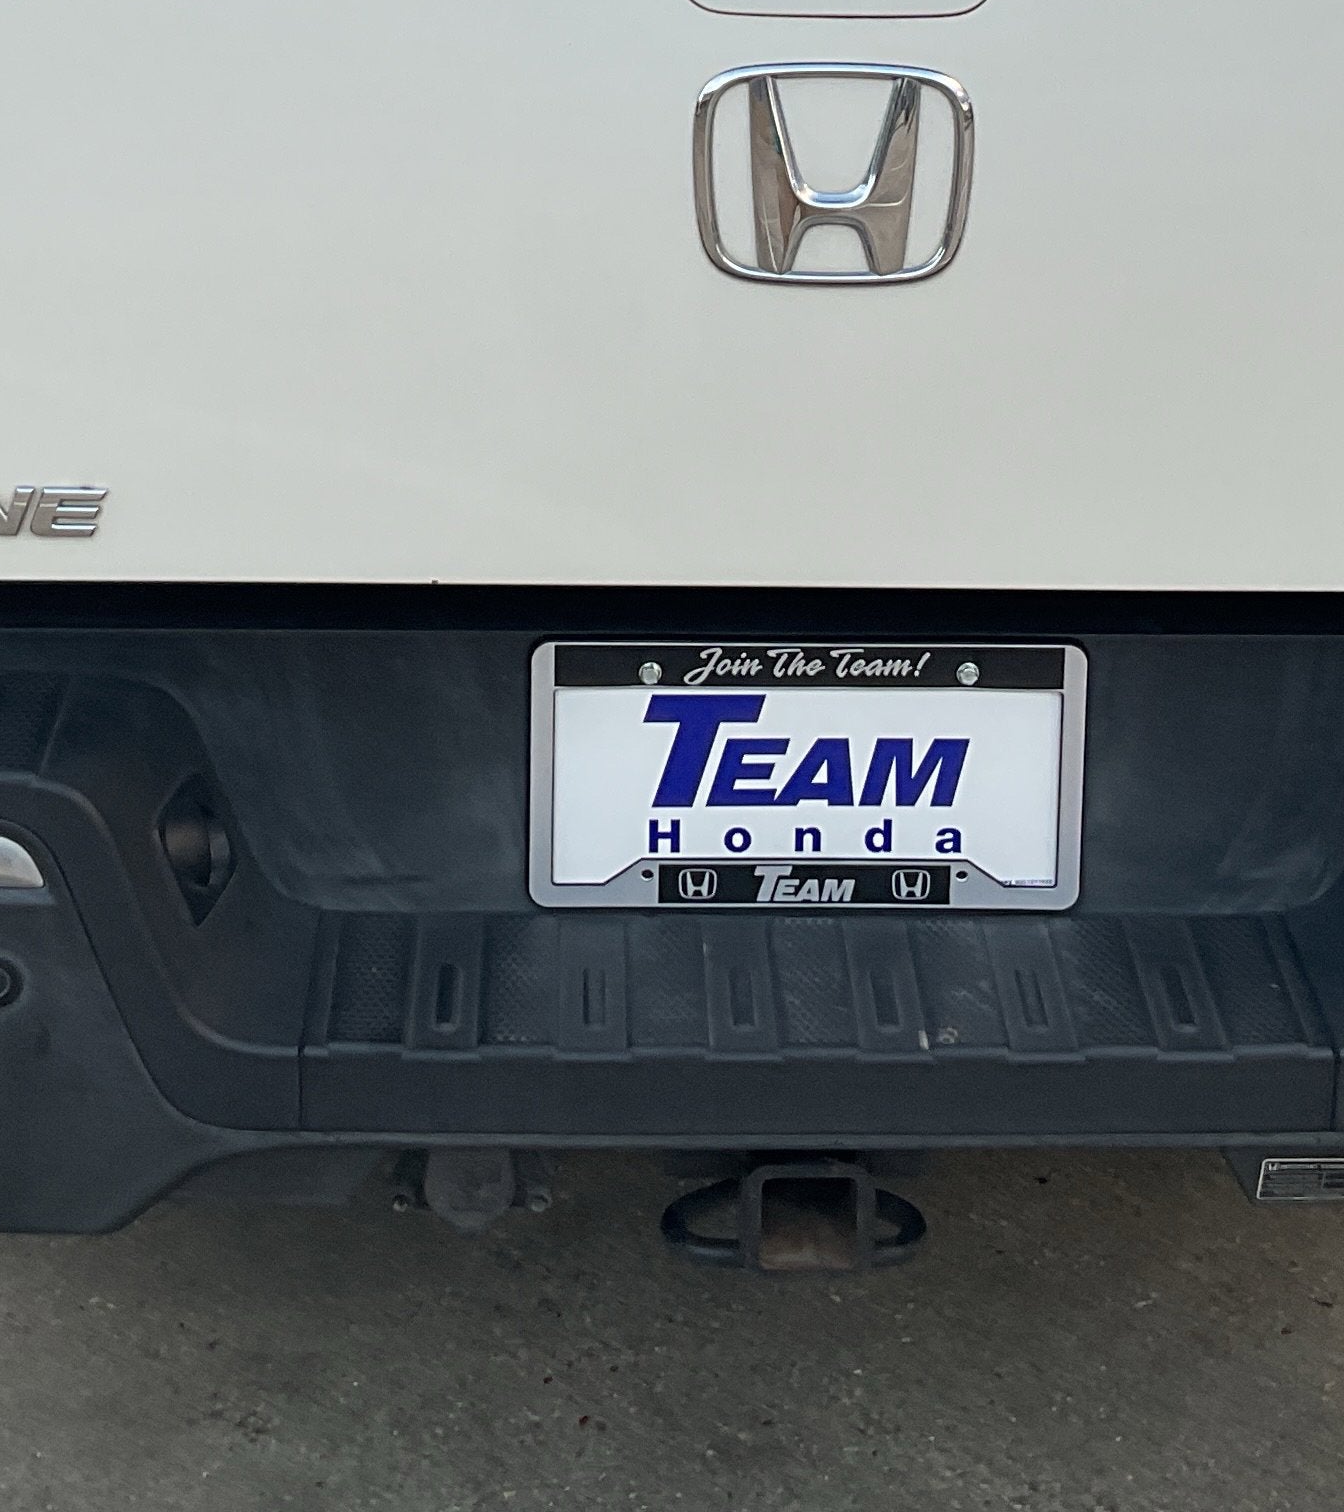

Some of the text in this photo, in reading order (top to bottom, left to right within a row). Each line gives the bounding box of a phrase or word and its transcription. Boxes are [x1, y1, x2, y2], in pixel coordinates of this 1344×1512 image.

[683, 647, 931, 686] Join The Team!
[642, 693, 971, 808] TEAM
[649, 819, 962, 853] Honda
[754, 864, 856, 902] TEAM
